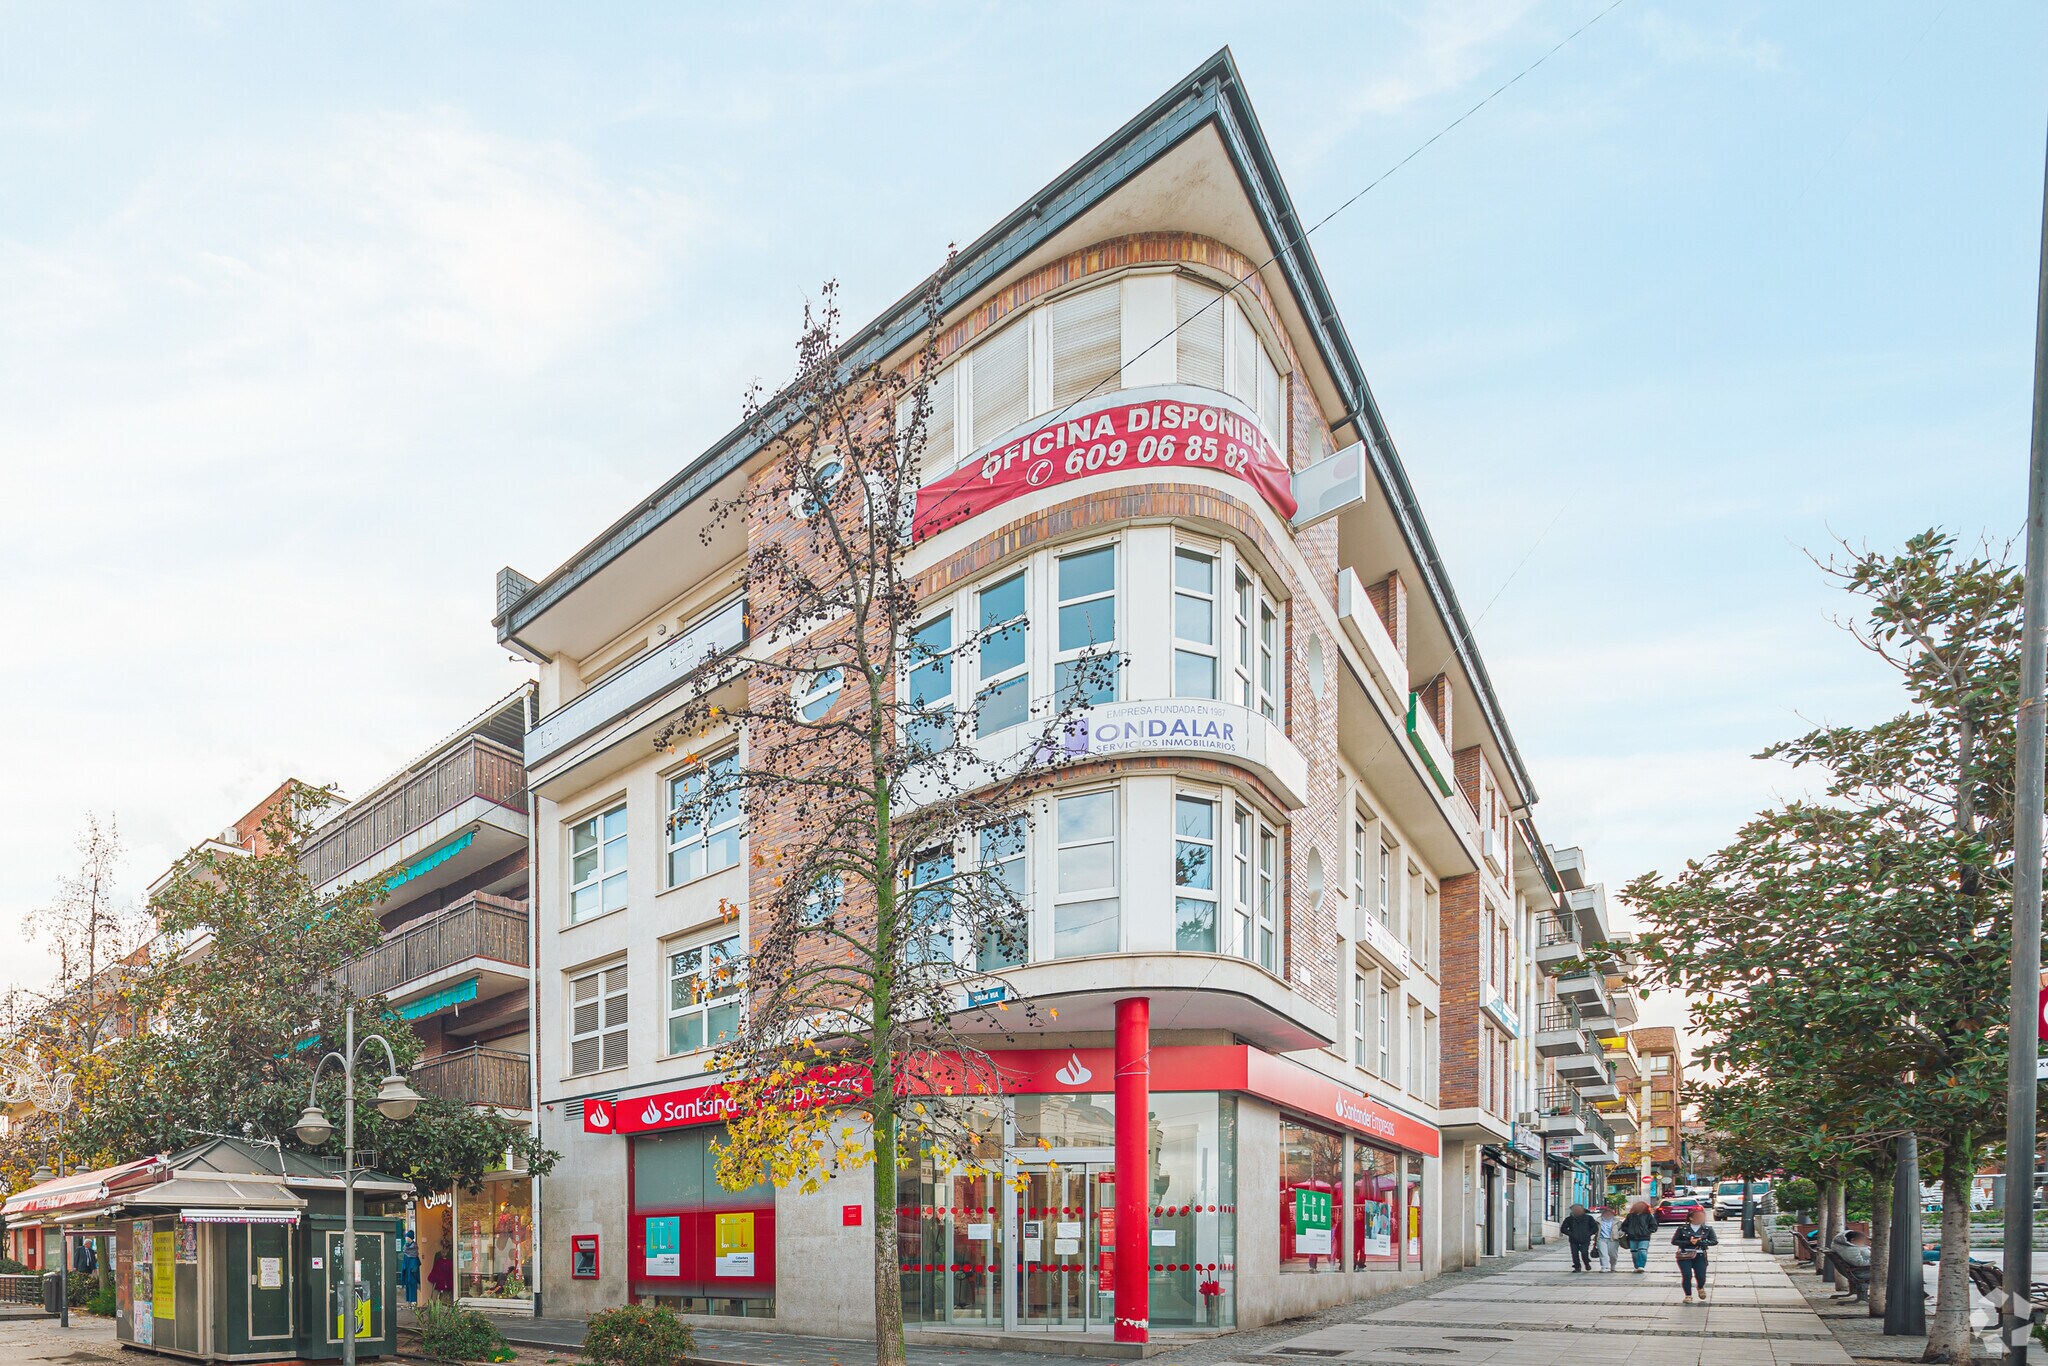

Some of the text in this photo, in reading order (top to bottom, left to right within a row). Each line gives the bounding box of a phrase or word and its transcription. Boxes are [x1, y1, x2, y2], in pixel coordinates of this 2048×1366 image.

[982, 403, 1267, 481] OFICINA DISPONIBLE
[1065, 435, 1249, 475] 609 06 85 82
[1106, 704, 1226, 719] EMPRESA FUNDADA EN 1987
[1095, 719, 1234, 742] ONDALAR
[1096, 738, 1236, 752] SERVICIOS INMOBILIARIOS
[1343, 1099, 1395, 1137] Santander Empresas
